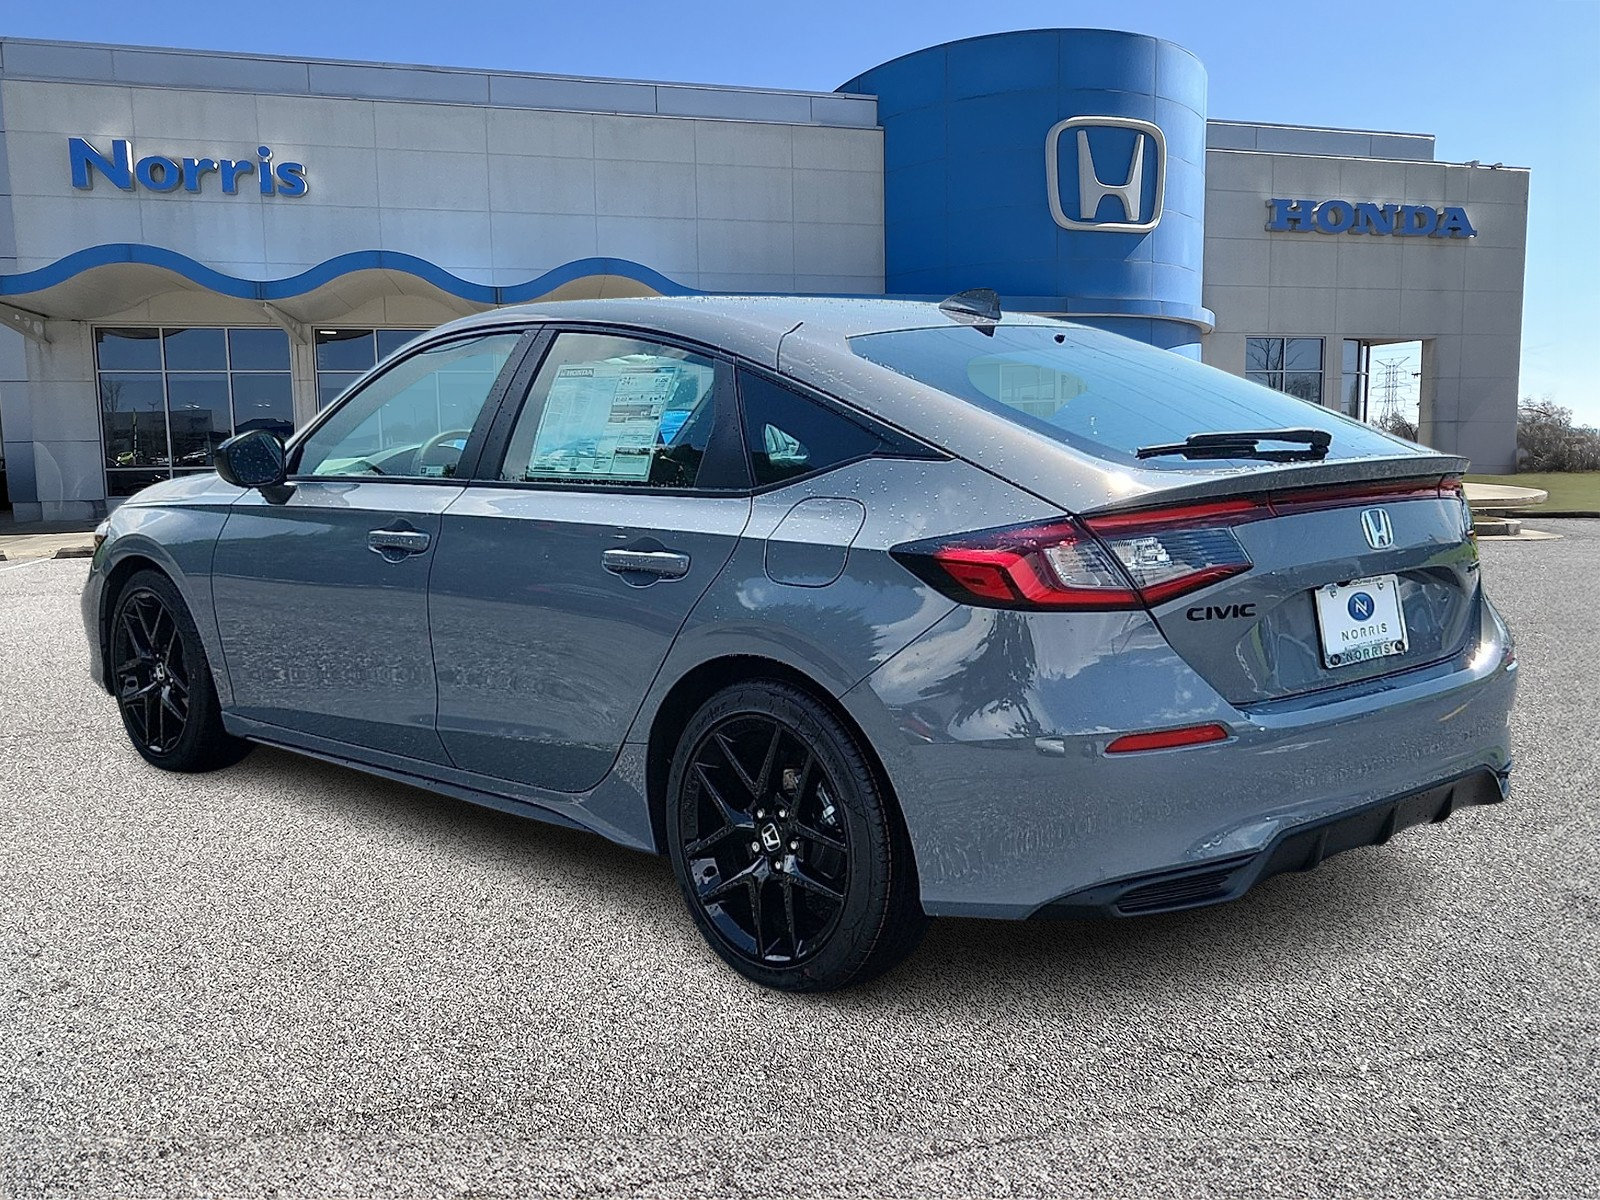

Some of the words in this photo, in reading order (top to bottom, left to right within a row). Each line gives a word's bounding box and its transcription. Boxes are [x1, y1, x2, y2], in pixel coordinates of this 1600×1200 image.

[68, 137, 309, 197] Norris
[1266, 198, 1478, 239] HONDA
[1186, 603, 1257, 621] CIVIC
[1341, 622, 1388, 642] NORRIS
[1346, 643, 1391, 661] NORRIS
